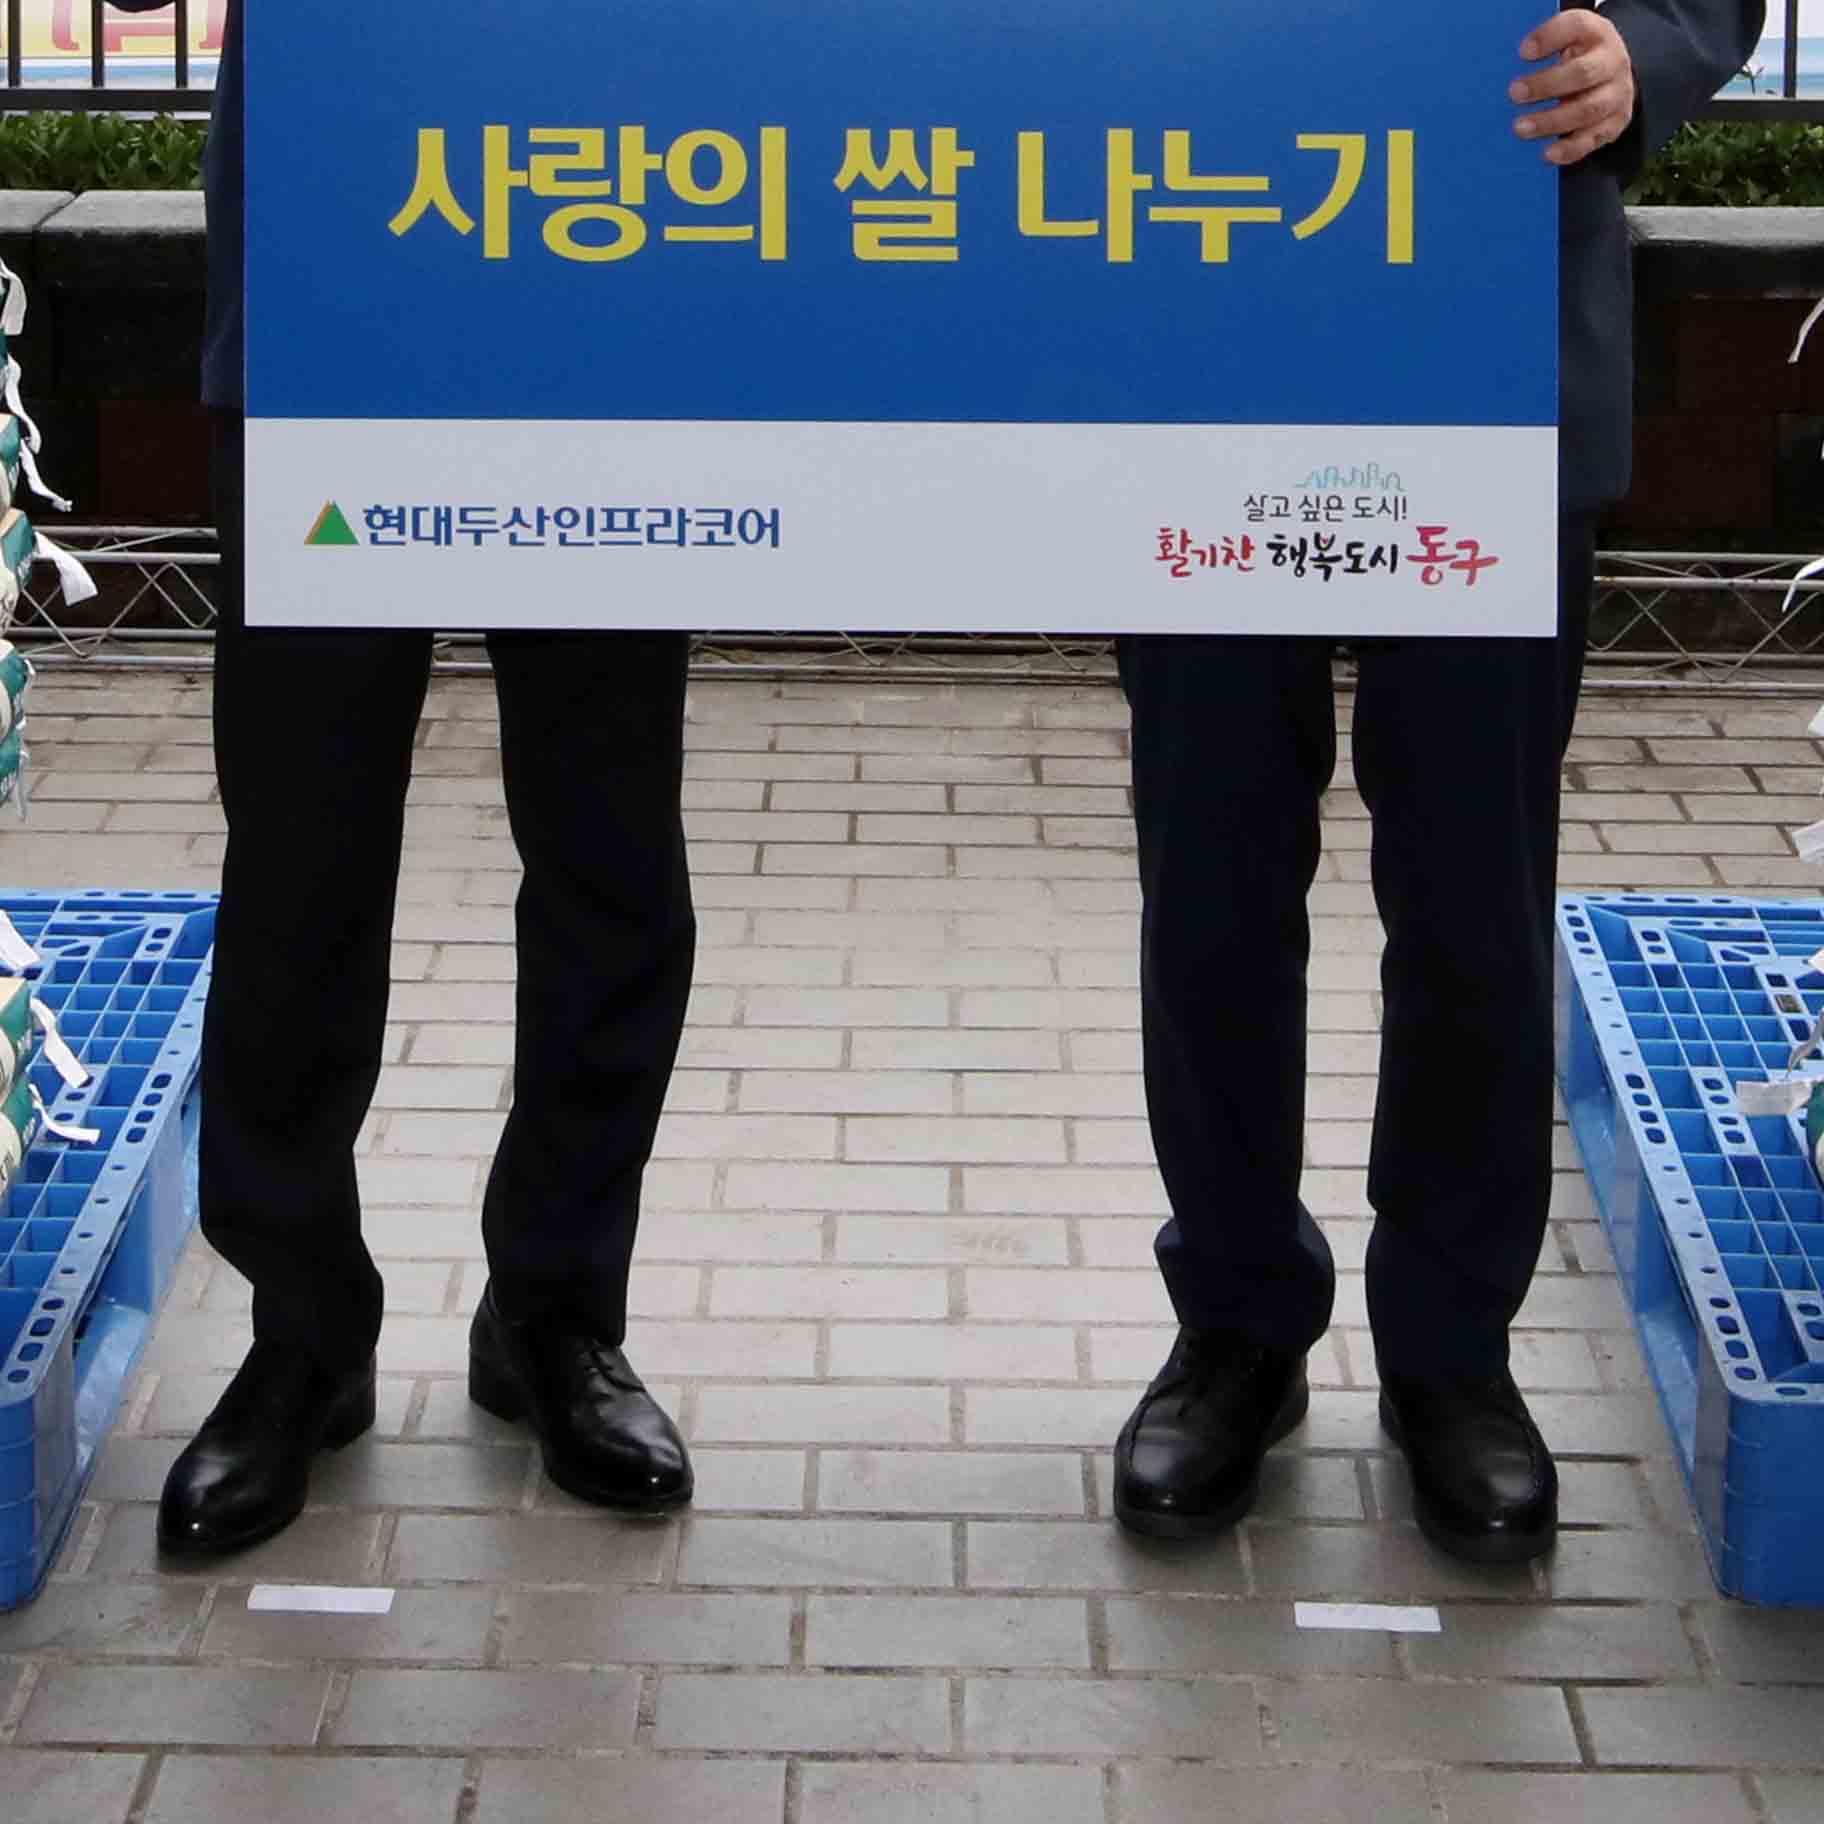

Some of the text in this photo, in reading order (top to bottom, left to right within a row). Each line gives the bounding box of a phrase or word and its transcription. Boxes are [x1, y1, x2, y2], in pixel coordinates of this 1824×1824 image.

[388, 124, 1413, 264] 사랑의 쌀 나누기
[362, 504, 781, 548] 현대두산인프라코어
[1243, 495, 1408, 523] 살고 싶은 도시!
[1154, 525, 1498, 586] 활기찬 행복도시 동구
